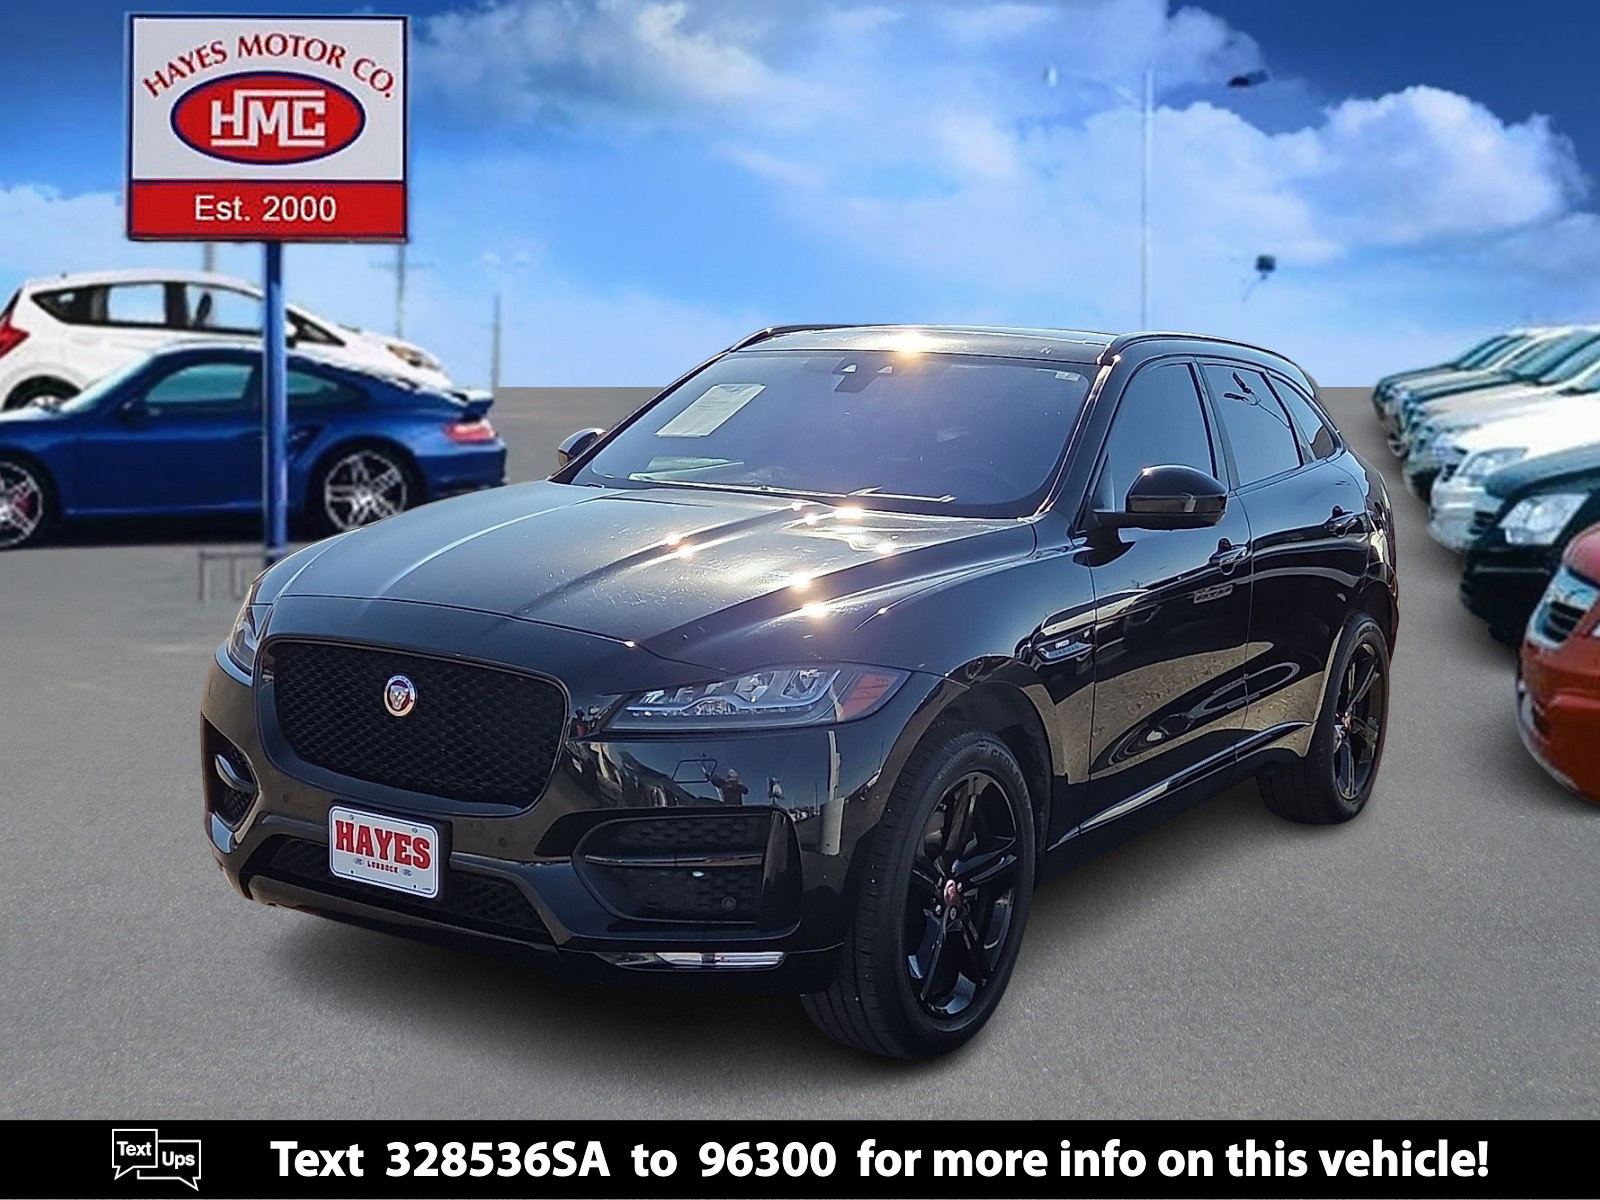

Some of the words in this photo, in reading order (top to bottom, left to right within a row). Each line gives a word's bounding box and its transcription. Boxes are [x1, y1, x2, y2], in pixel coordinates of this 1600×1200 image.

[142, 40, 228, 98] HAYES
[238, 33, 346, 69] MOTOR
[352, 57, 394, 98] CO.
[210, 89, 327, 147] HMC
[194, 195, 251, 221] Est.
[262, 195, 337, 222] 2000
[335, 819, 431, 870] HAYES
